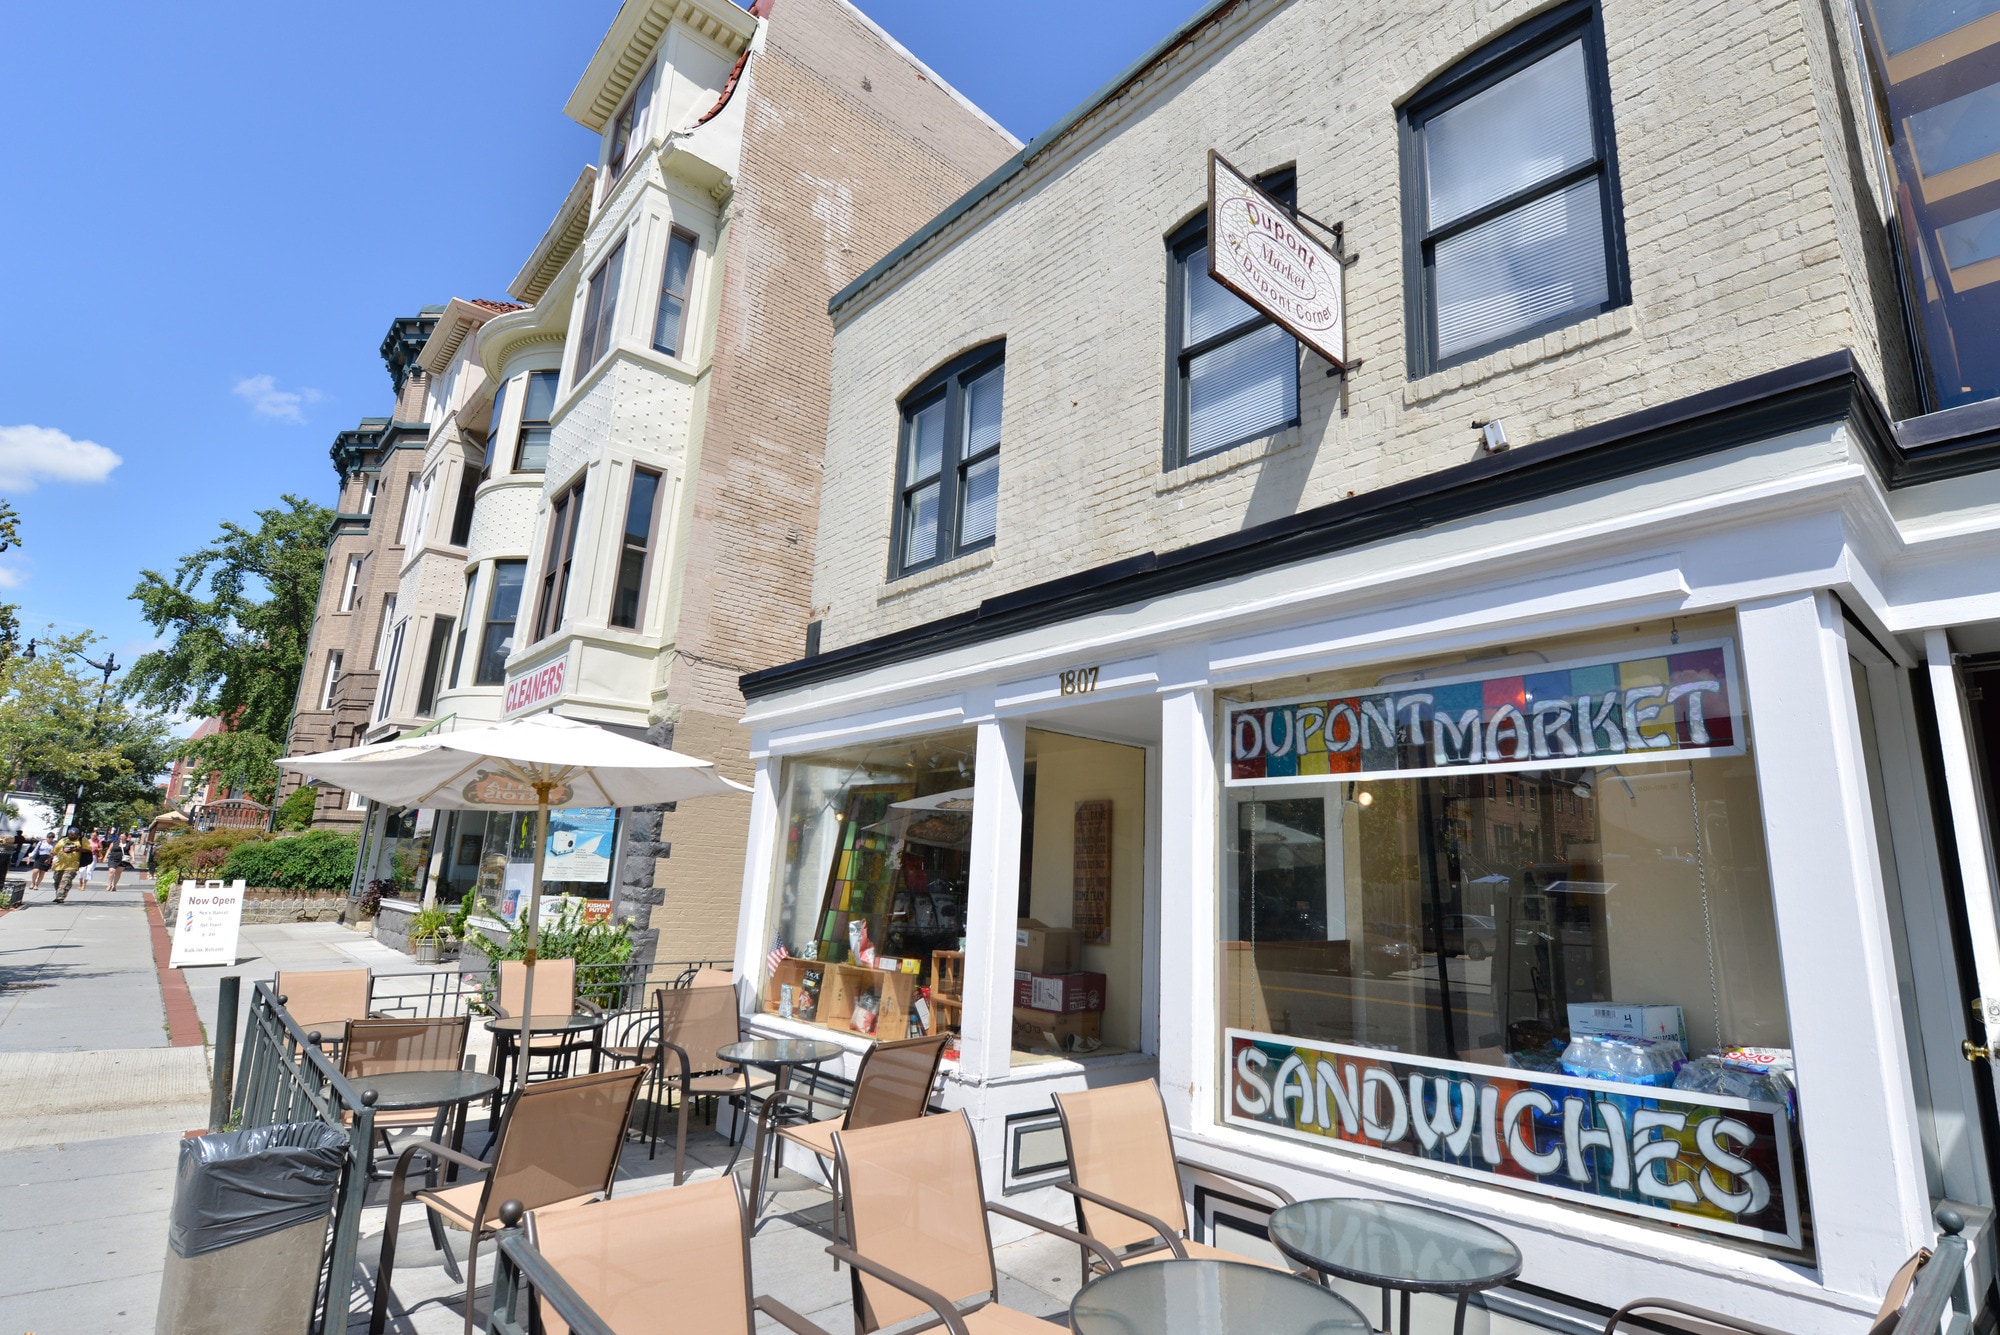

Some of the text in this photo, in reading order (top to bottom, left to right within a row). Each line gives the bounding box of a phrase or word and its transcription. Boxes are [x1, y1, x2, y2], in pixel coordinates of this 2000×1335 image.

[1246, 201, 1315, 272] Dupont
[1243, 255, 1291, 312] Dupont
[1296, 303, 1332, 323] Corner
[1260, 243, 1308, 291] Market
[505, 661, 564, 714] CLEANERS
[1059, 666, 1099, 697] 1807
[1235, 680, 1720, 766] DUPONT MARKET
[188, 896, 236, 907] Now Open
[502, 901, 515, 915] 30
[1236, 1046, 1770, 1214] SANDWICHES
